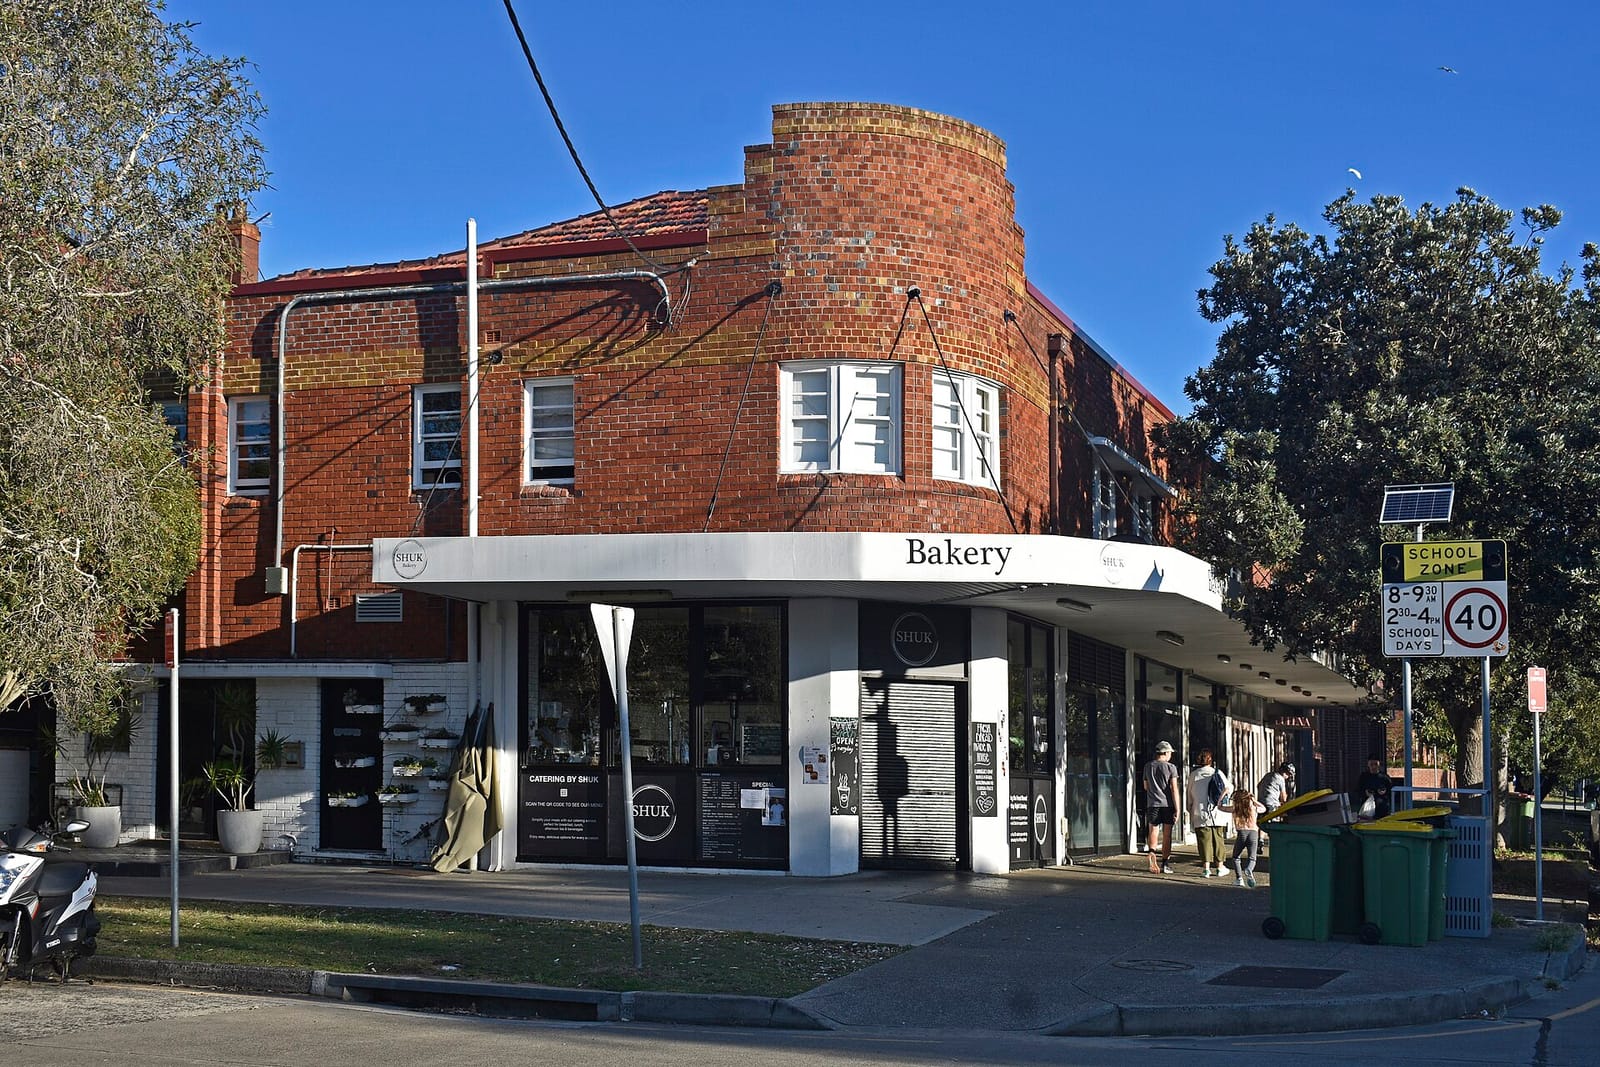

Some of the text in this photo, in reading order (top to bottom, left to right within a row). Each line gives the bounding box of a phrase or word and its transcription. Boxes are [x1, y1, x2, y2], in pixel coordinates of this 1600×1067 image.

[396, 553, 422, 562] SHUK
[905, 538, 1012, 575] Bakery
[1409, 547, 1477, 559] SCHOOL
[1103, 556, 1125, 568] SHUK
[1420, 563, 1467, 575] ZONE
[1455, 604, 1497, 631] 40
[896, 631, 933, 643] SHUK
[1389, 628, 1439, 638] SCHOOL
[1396, 641, 1432, 651] DAYS
[836, 737, 854, 745] OPEN
[529, 775, 599, 783] CATERING BY SHUK
[632, 804, 671, 817] SHUK
